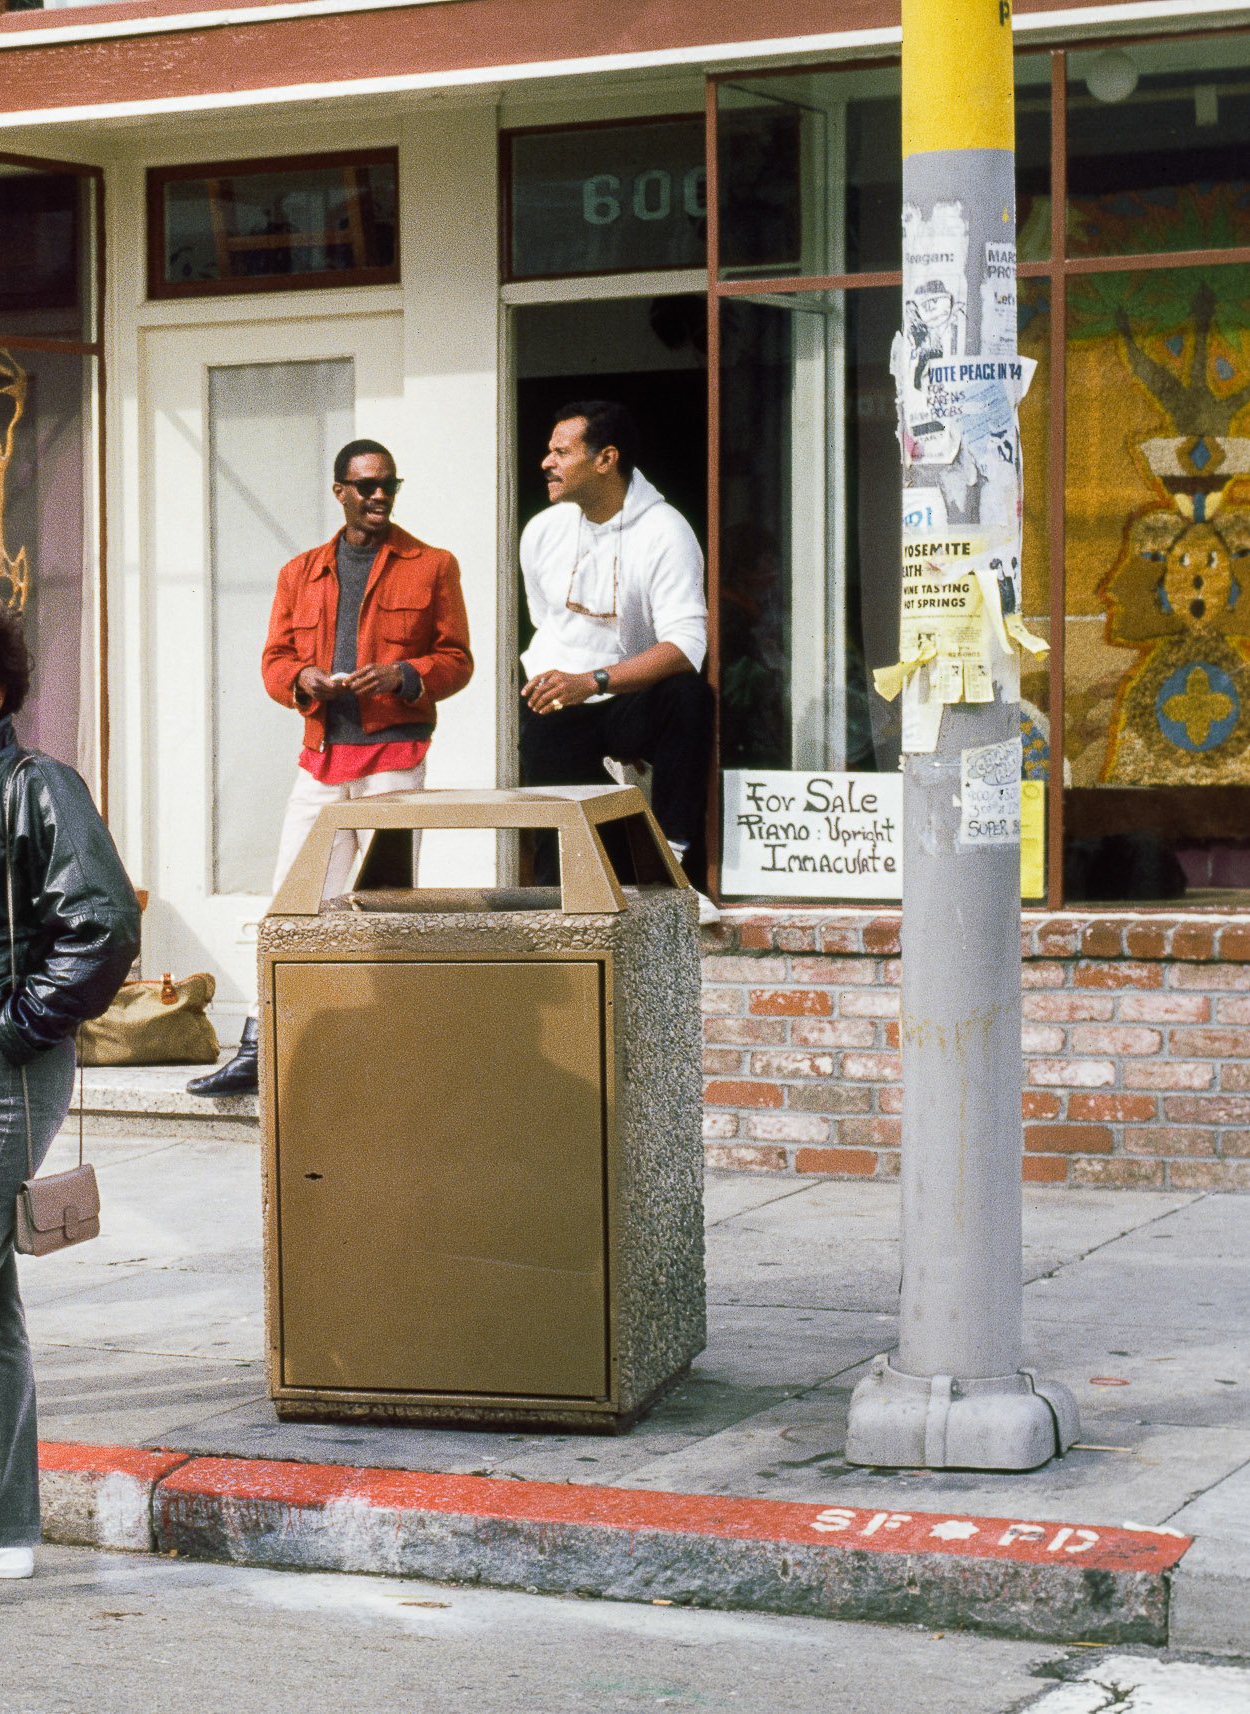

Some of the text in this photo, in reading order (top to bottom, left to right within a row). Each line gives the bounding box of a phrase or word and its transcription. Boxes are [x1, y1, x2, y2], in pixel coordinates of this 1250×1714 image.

[928, 366, 956, 384] VOTE
[960, 363, 996, 381] PEACE
[998, 363, 1007, 380] IN
[904, 542, 970, 558] YOSEMITE
[921, 583, 970, 594] TASTING
[917, 598, 966, 609] SPRINGS
[824, 816, 895, 848] Upright
